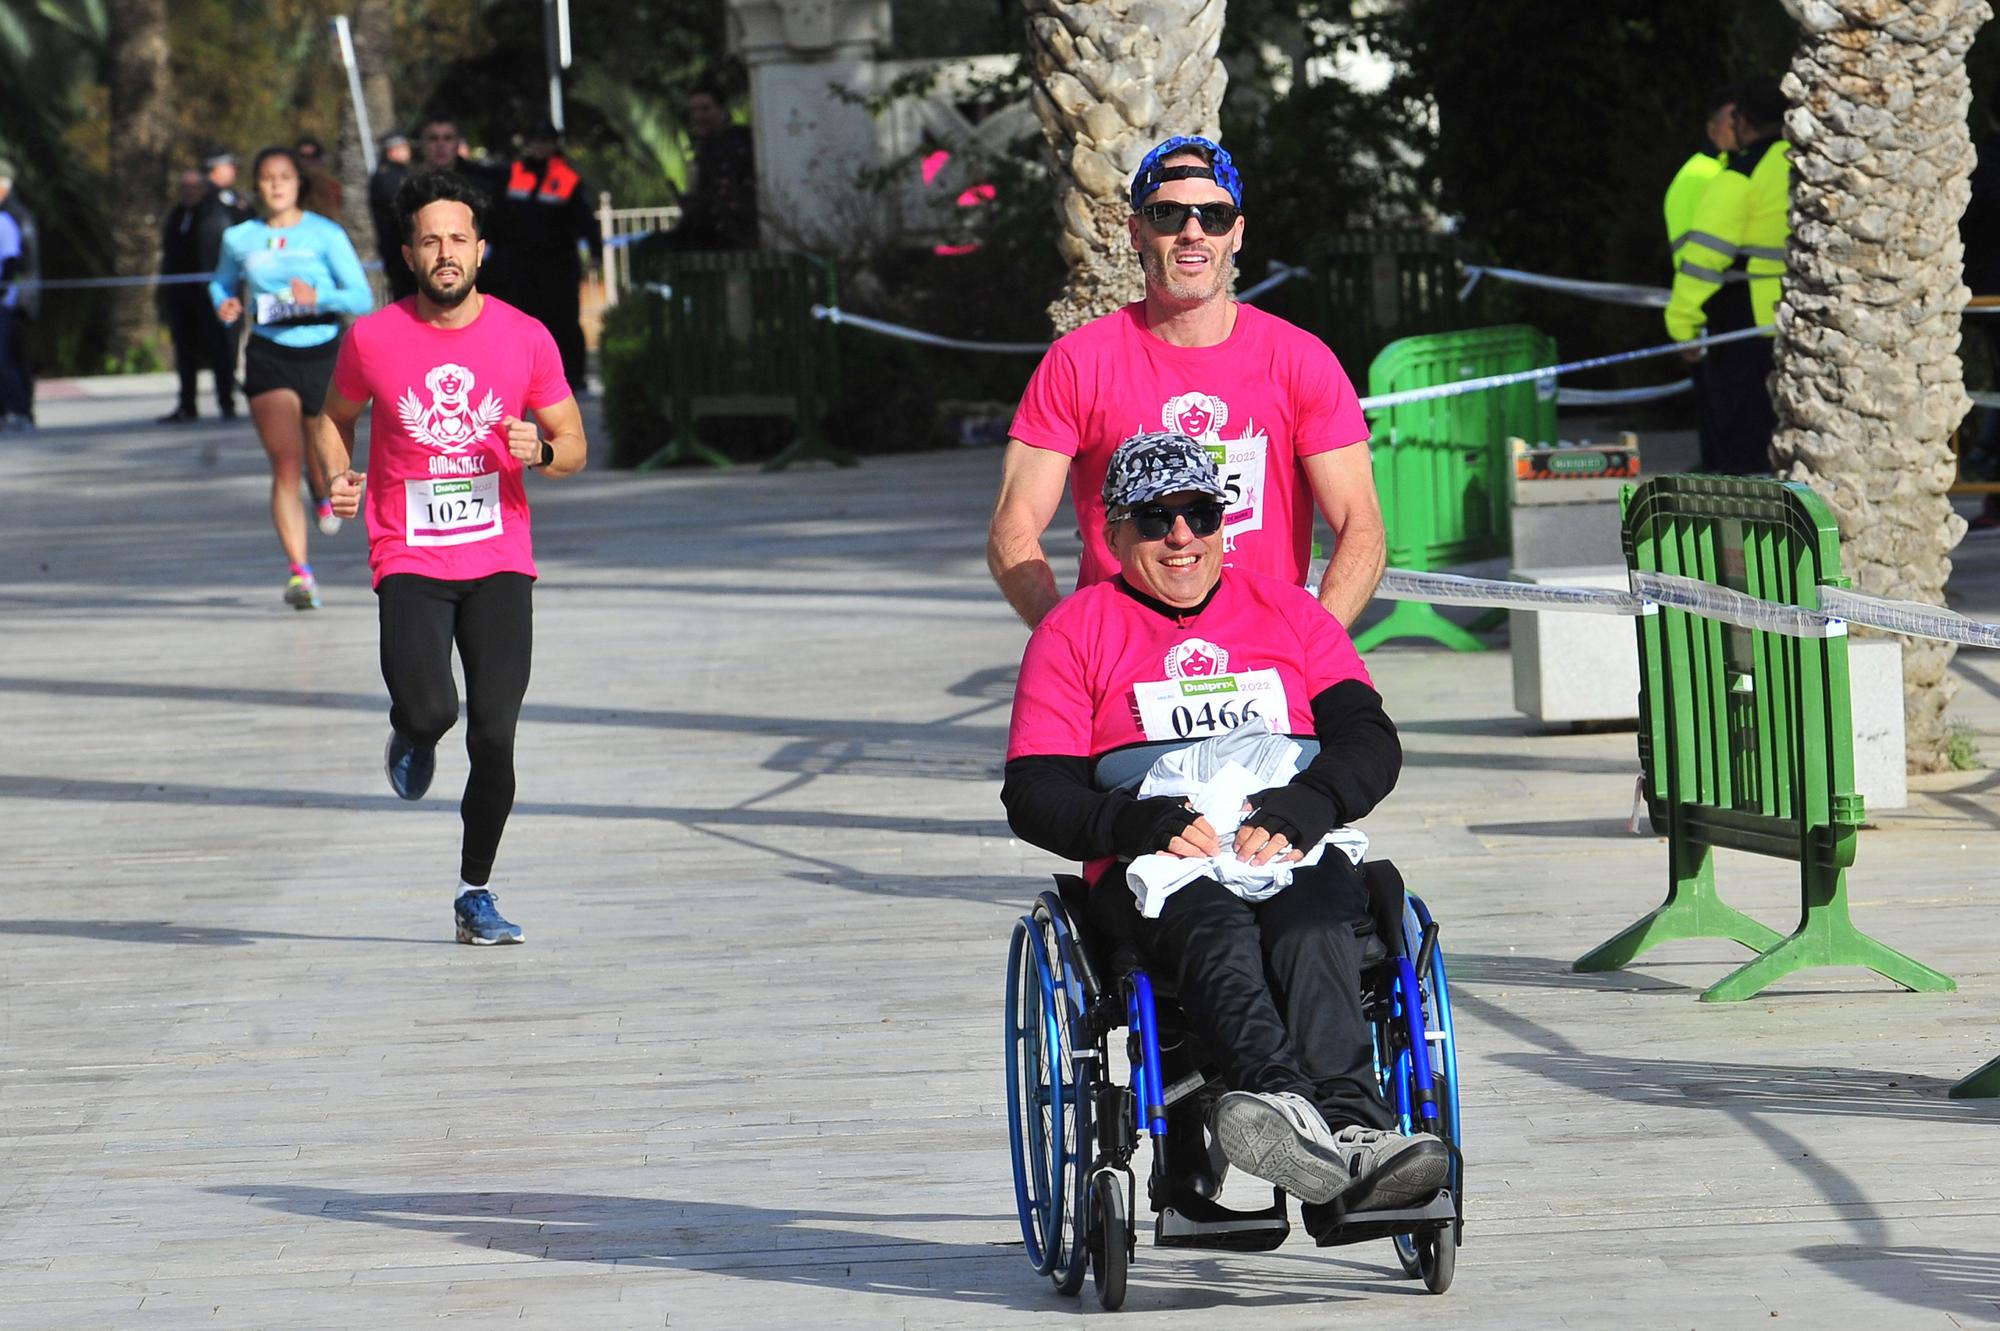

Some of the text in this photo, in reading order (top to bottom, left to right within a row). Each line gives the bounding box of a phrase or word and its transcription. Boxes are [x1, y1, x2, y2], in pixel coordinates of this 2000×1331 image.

[1228, 451, 1256, 463] 2022
[426, 498, 484, 524] 1027
[1183, 680, 1271, 693] Dialprix 2022
